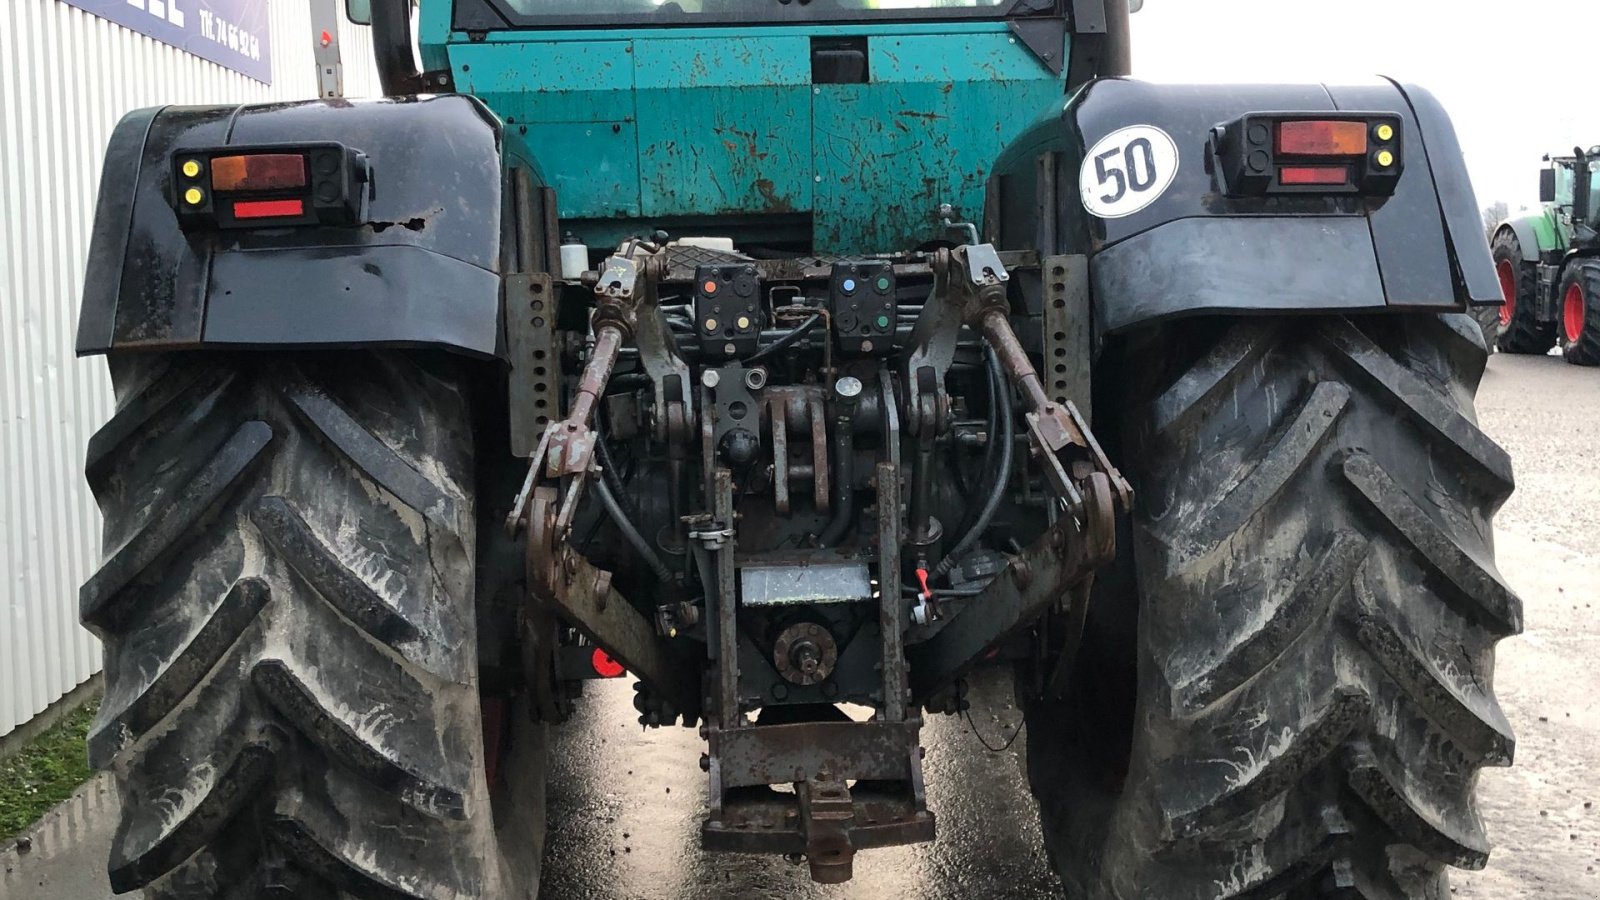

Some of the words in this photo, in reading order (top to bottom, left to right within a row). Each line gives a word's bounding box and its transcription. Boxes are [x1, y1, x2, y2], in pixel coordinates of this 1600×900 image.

[215, 17, 227, 46] 74
[239, 29, 250, 57] 92
[1094, 137, 1157, 204] 50
